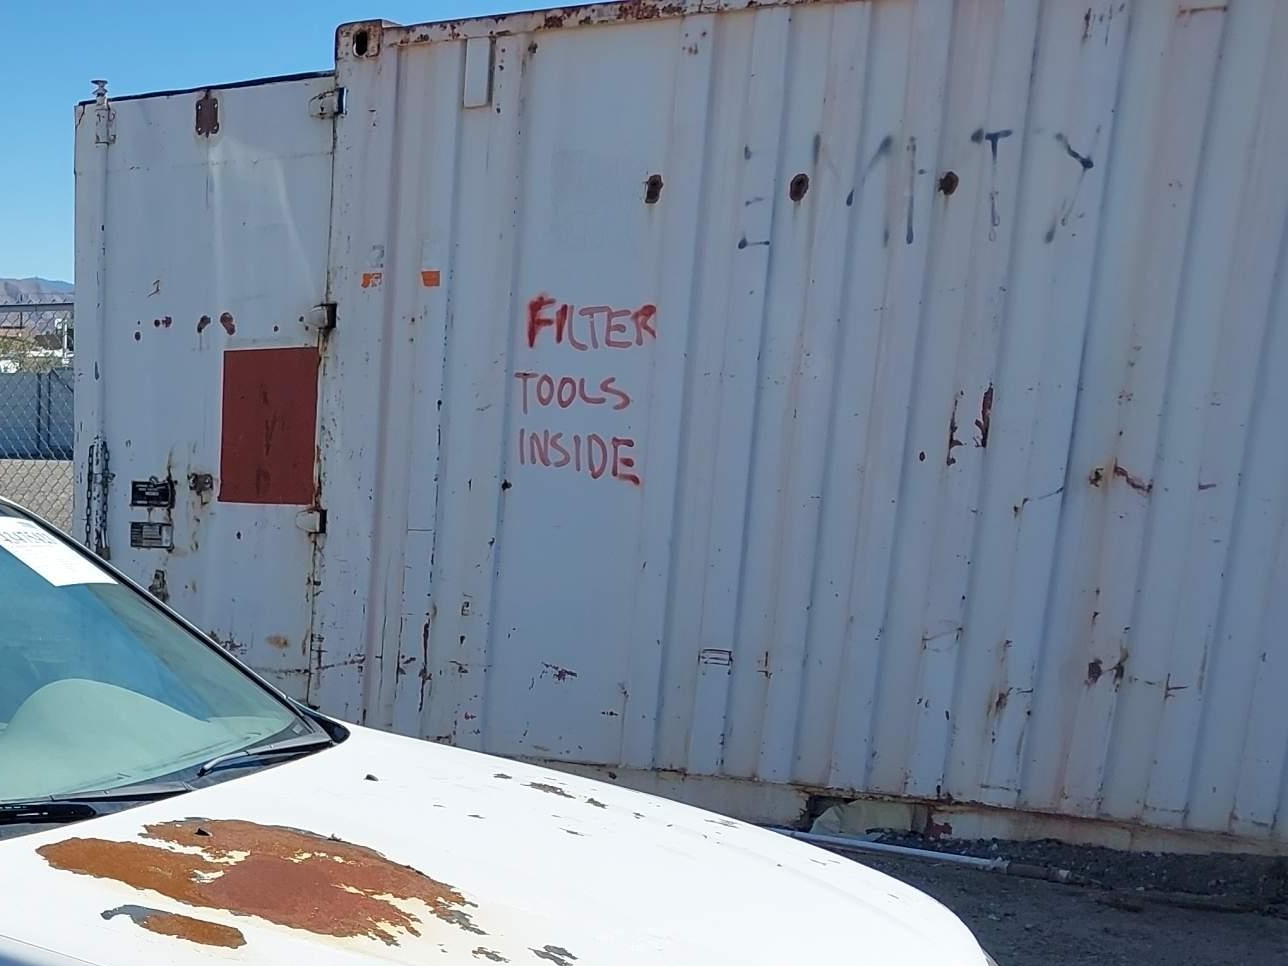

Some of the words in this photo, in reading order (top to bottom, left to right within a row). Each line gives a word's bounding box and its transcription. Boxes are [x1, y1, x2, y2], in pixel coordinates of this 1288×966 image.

[527, 295, 657, 351] FILTER
[514, 371, 632, 415] TOOLS
[519, 427, 640, 486] INSIDE
